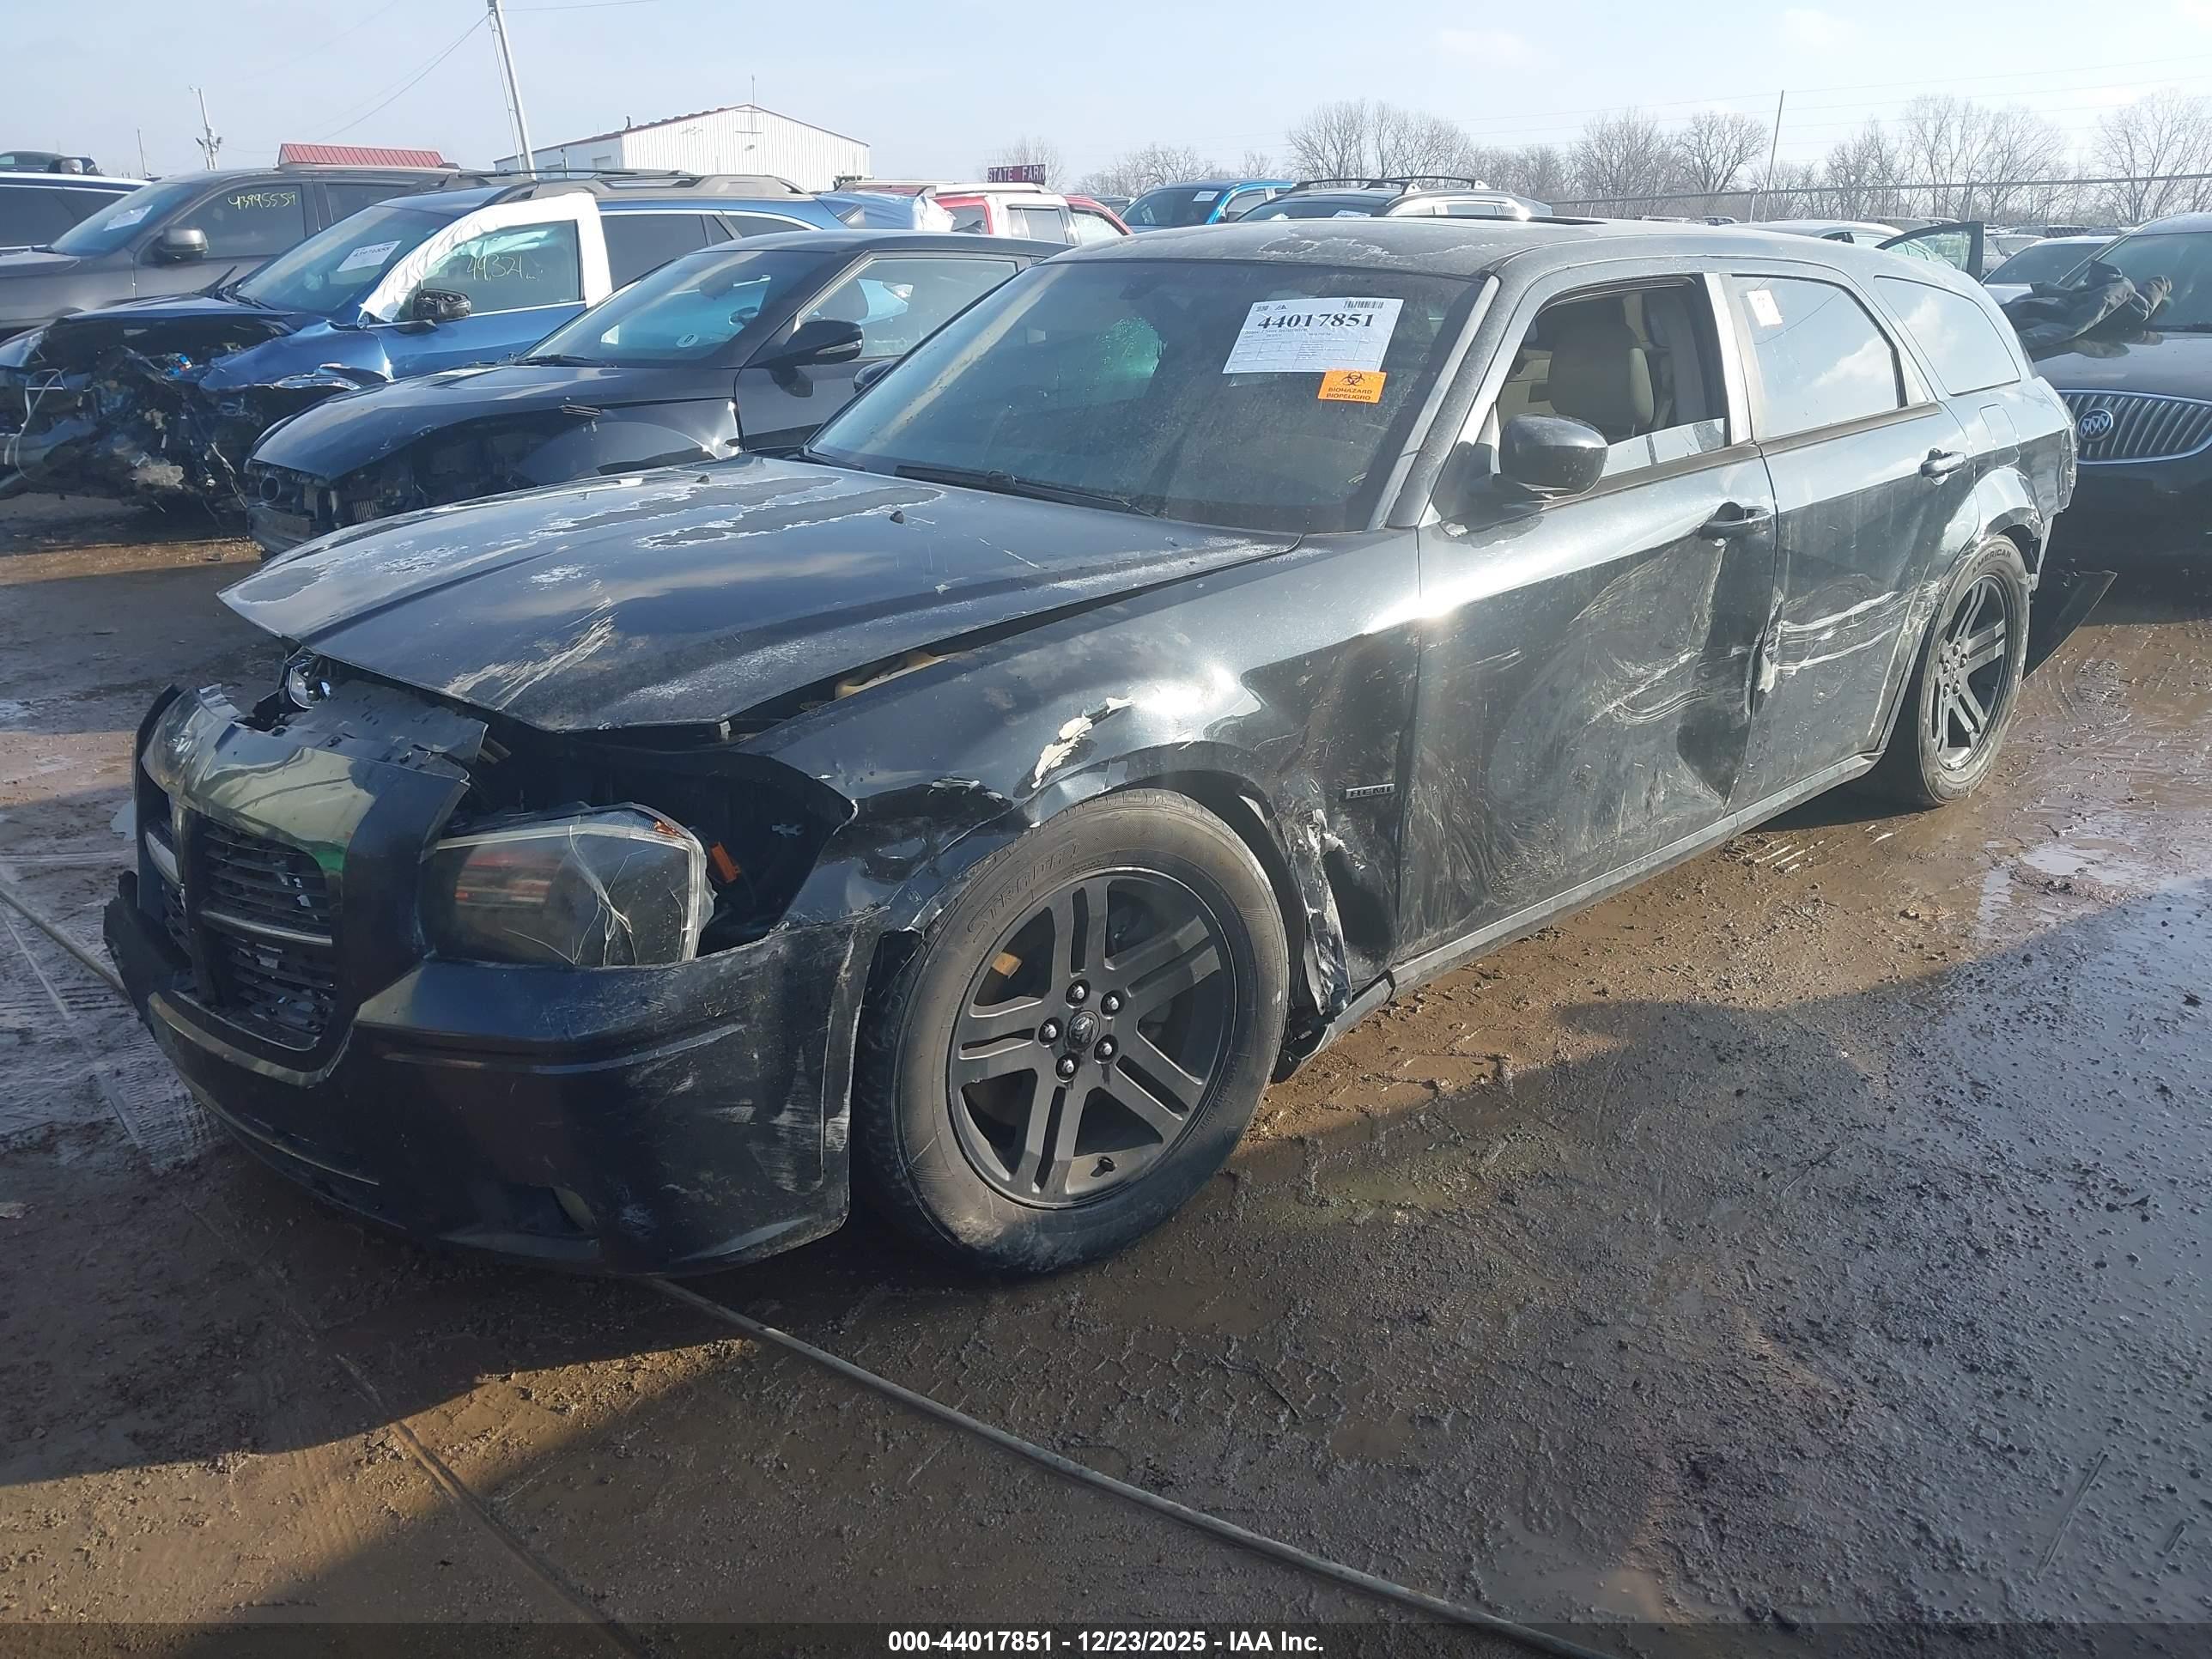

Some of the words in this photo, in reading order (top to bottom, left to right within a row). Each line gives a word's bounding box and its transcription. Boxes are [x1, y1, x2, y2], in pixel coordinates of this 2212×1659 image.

[988, 167, 1013, 182] STATE
[1022, 166, 1045, 181] FARM
[1257, 313, 1375, 329] 44017851
[1326, 392, 1371, 401] BIOPELIGRO
[1972, 549, 2012, 576] AMERICAN
